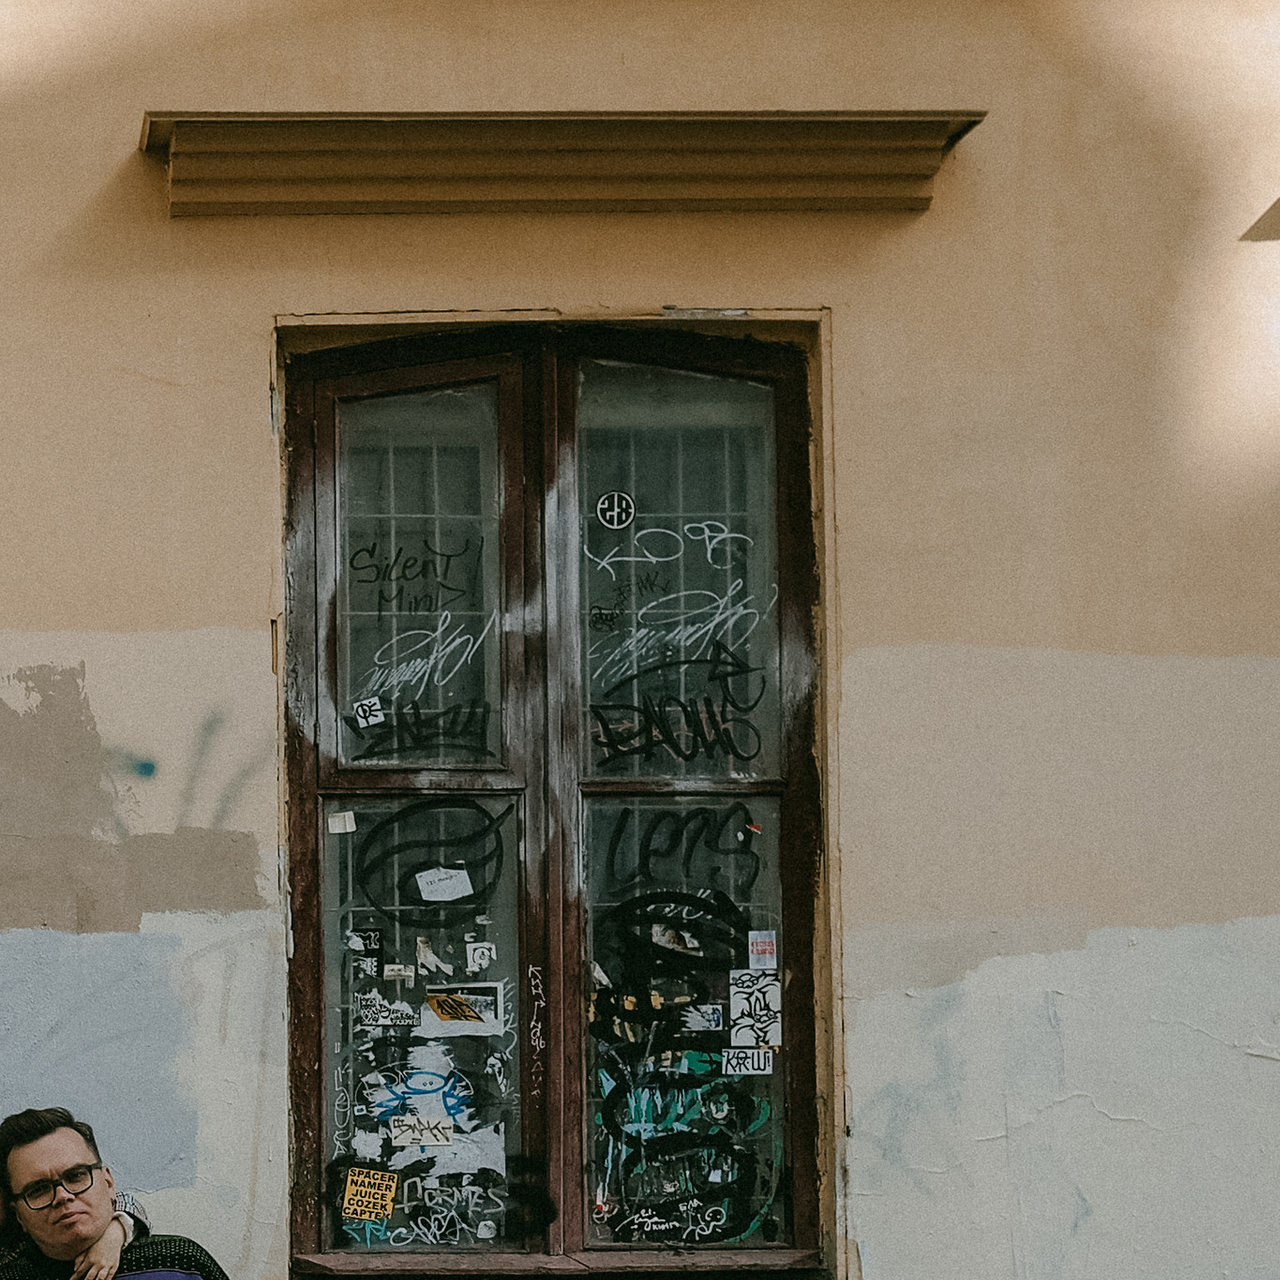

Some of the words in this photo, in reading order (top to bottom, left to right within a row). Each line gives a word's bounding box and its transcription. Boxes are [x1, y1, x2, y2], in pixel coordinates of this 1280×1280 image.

[349, 1168, 396, 1184] SPACER
[350, 1178, 393, 1193] NAMER
[351, 1189, 388, 1202] JUICE
[347, 1198, 389, 1212] COZEK
